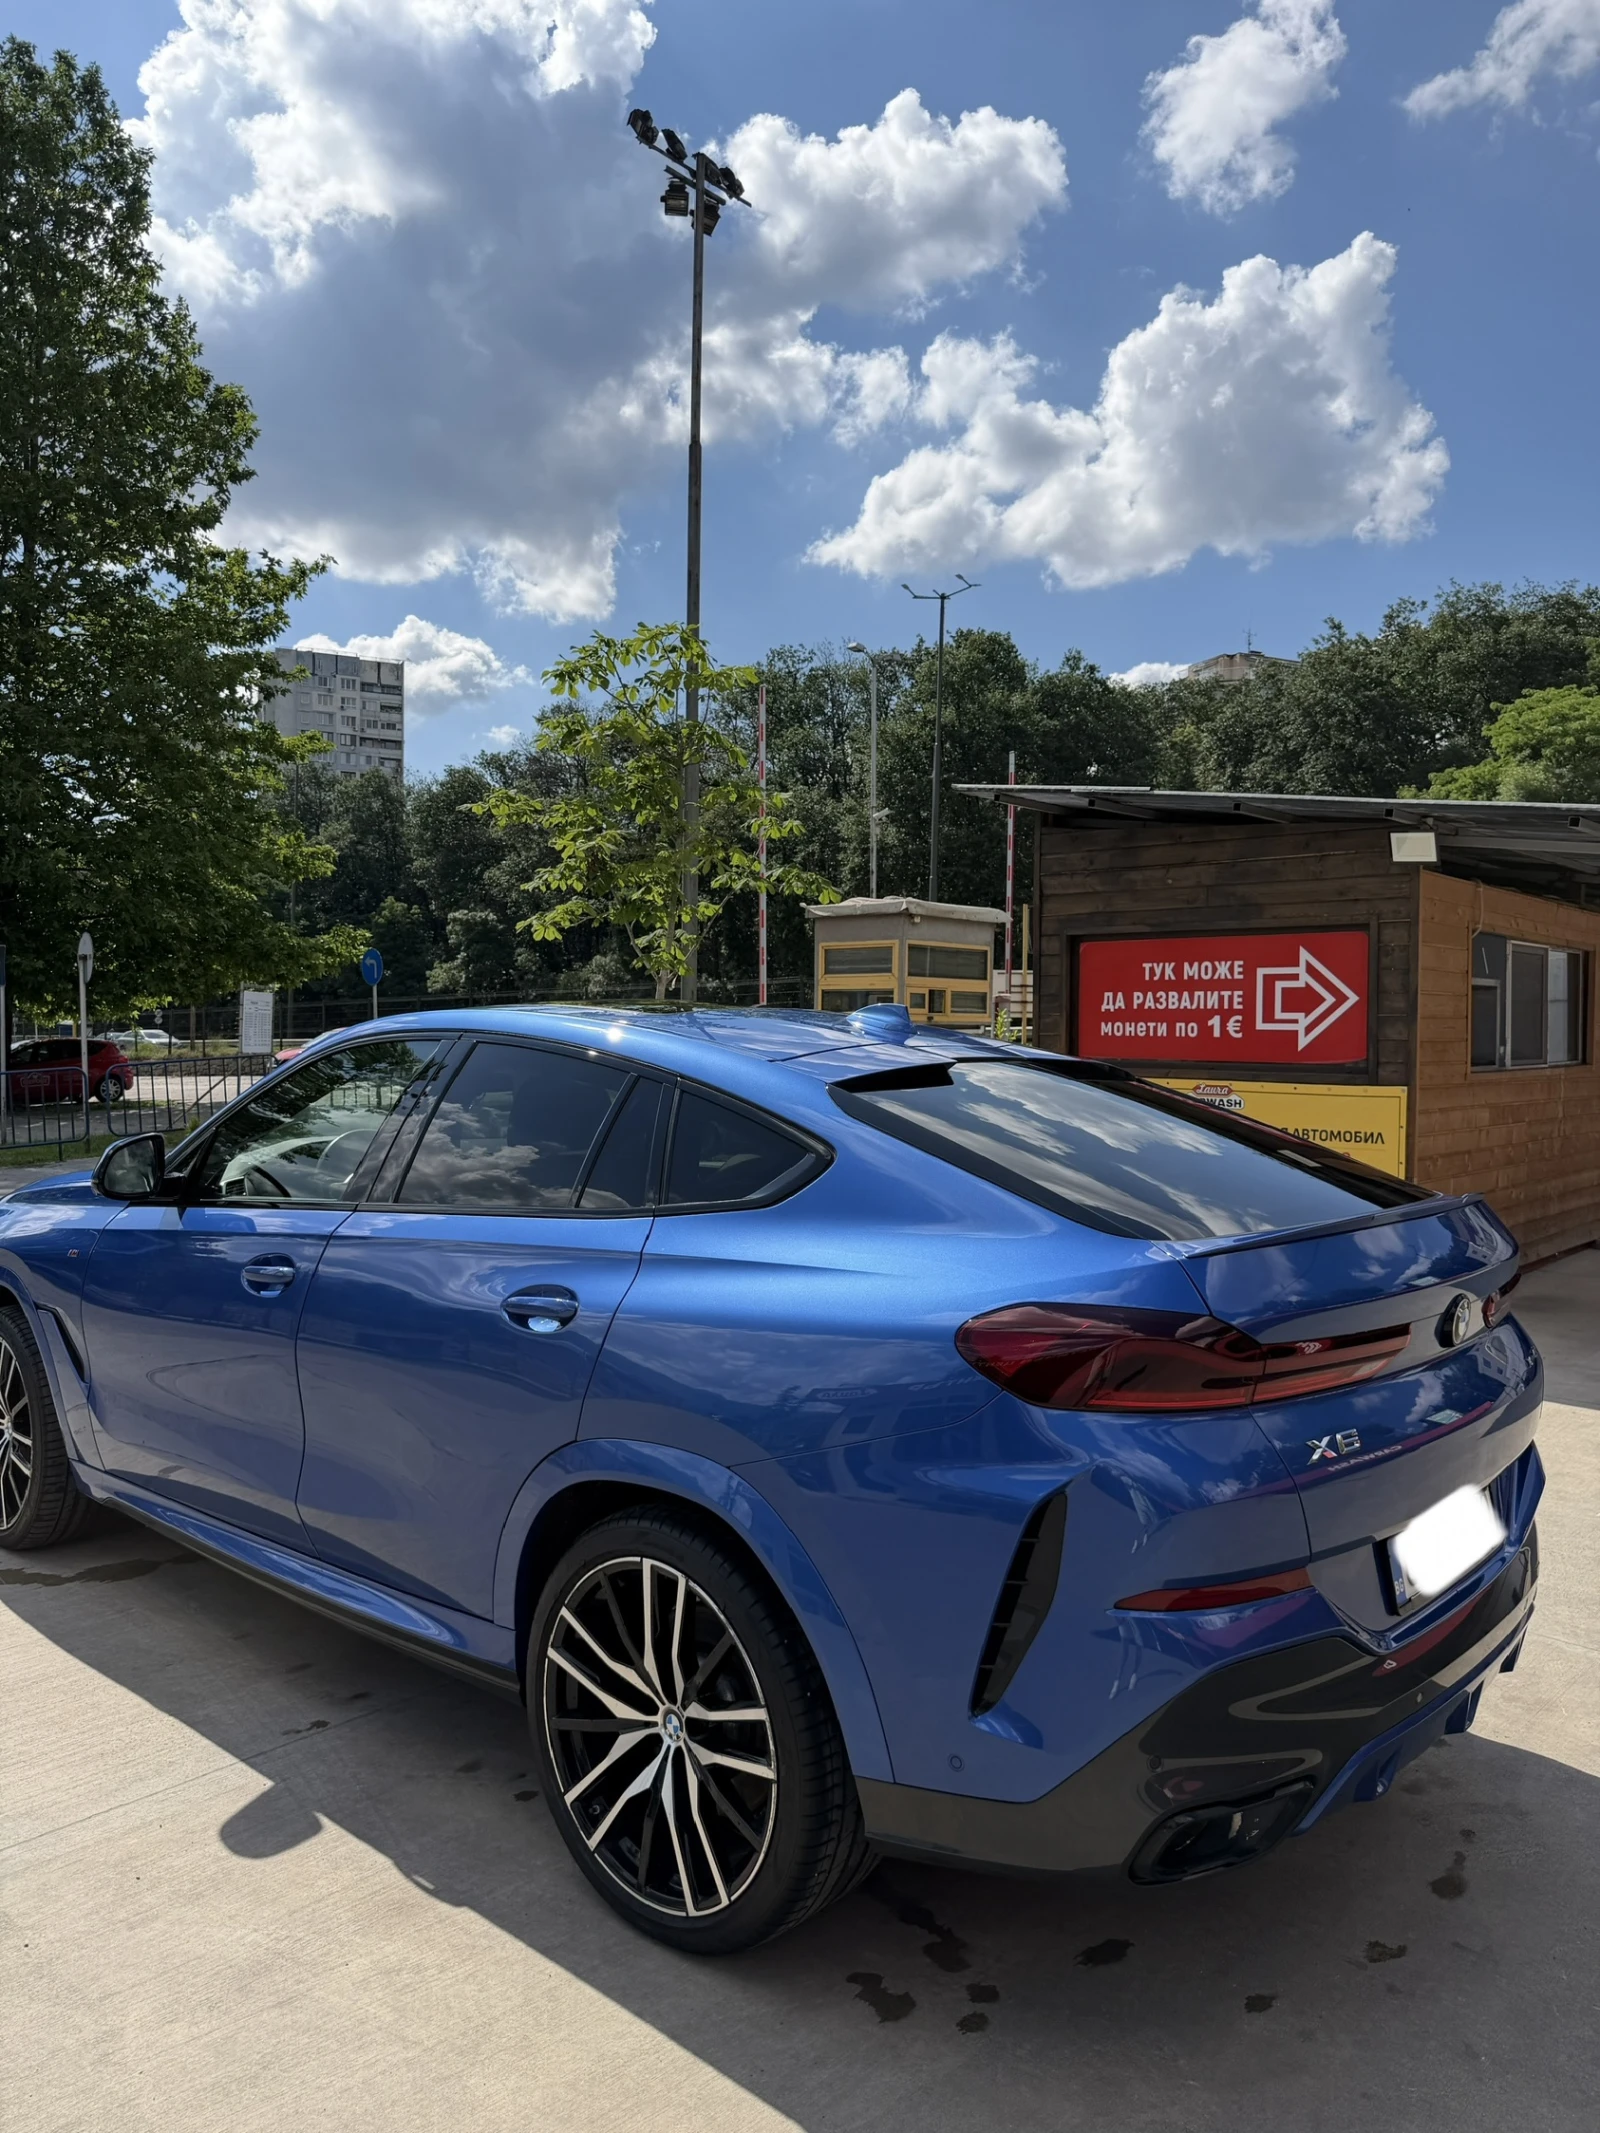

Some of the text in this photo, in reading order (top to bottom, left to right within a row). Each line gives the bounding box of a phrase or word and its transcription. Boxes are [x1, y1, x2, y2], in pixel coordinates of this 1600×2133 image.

[1142, 960, 1244, 981] ТУК МОЖЕ
[1101, 990, 1244, 1013] ДА РАЗВАЛИТЕ
[1100, 1021, 1167, 1037] монети
[1175, 1022, 1198, 1038] по
[1195, 1083, 1230, 1095] Laura
[1292, 1128, 1386, 1145] АВТОМОБИЛ
[1305, 1428, 1361, 1466] X6
